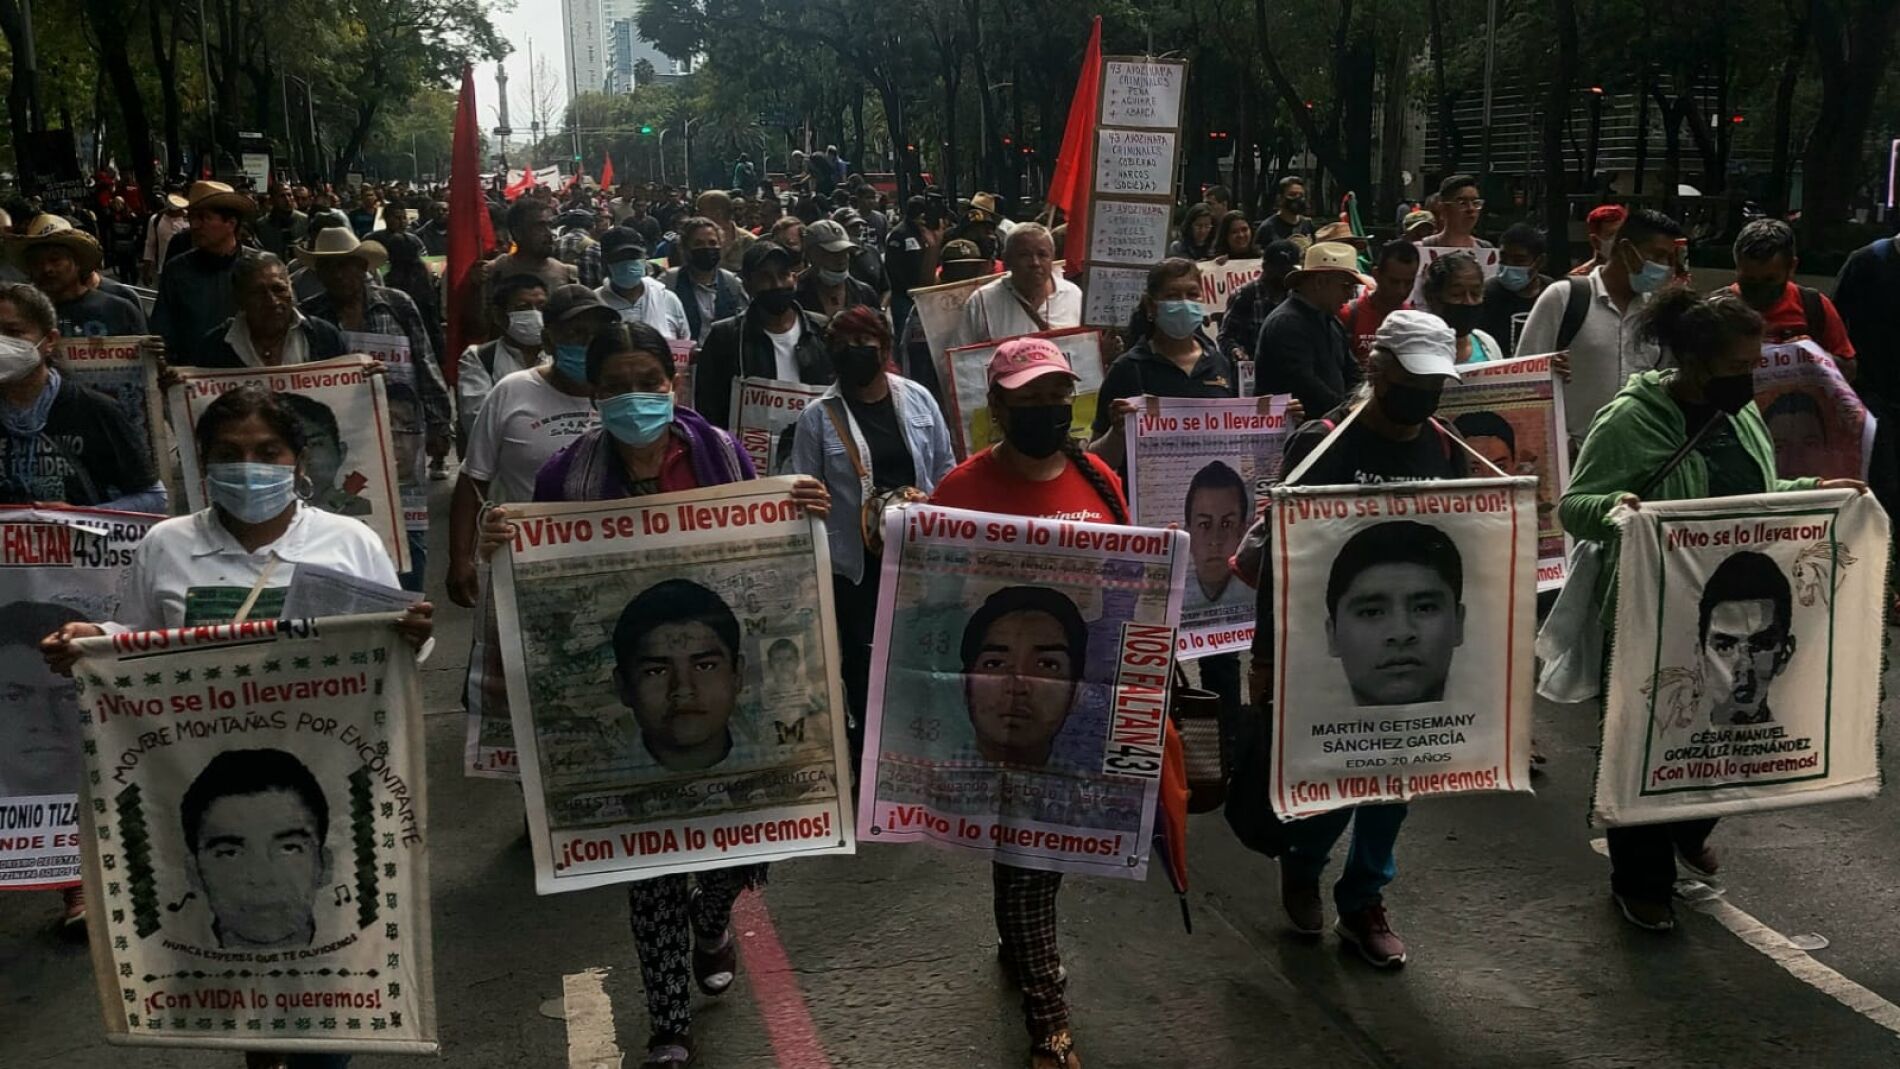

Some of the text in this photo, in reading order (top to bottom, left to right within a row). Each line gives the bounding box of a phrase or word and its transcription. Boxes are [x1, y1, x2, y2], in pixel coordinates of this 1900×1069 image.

[744, 388, 805, 411] ¡Vivo se
[1139, 411, 1287, 437] ¡Vivo se lo llevaron!
[1354, 498, 1379, 517] se
[1385, 494, 1407, 516] lo
[513, 498, 804, 552] ¡Vivo se lo llevaron!
[908, 511, 1170, 556] ¡Vivo se lo llevaron!
[1668, 520, 1829, 552] ¡Vivo se lo llevaron!
[4, 524, 71, 564] FALTAN
[1190, 632, 1204, 648] lo
[97, 672, 368, 724] ¡Vivo se lo llevaron!
[1105, 624, 1172, 779] NOS FALTAN 43!
[1311, 714, 1476, 737] MARTÍN GETSEMANY
[1690, 727, 1788, 745] CÉSAR MANUEL
[1323, 732, 1466, 753] SÁNCHEZ GARCÍA
[1731, 738, 1812, 756] HERNÁNDEZ
[1346, 759, 1386, 768] EDAD
[1413, 752, 1452, 763] AÑOS
[1652, 752, 1819, 787] ¡Con VIDA lo queremos!
[112, 711, 424, 848] MOVERE MONTAÑAS POR ENCONTRARTE
[1290, 780, 1331, 806] ¡Con
[1336, 775, 1381, 797] VIDA
[1408, 767, 1499, 794] queremos!
[562, 811, 831, 868] ¡Con VIDA lo queremos!
[887, 805, 950, 834] ¡Vivo
[958, 817, 981, 840] lo
[989, 822, 1122, 856] queremos!
[283, 951, 298, 962] TE
[144, 987, 383, 1014] ¡Con VIDA lo queremos!
